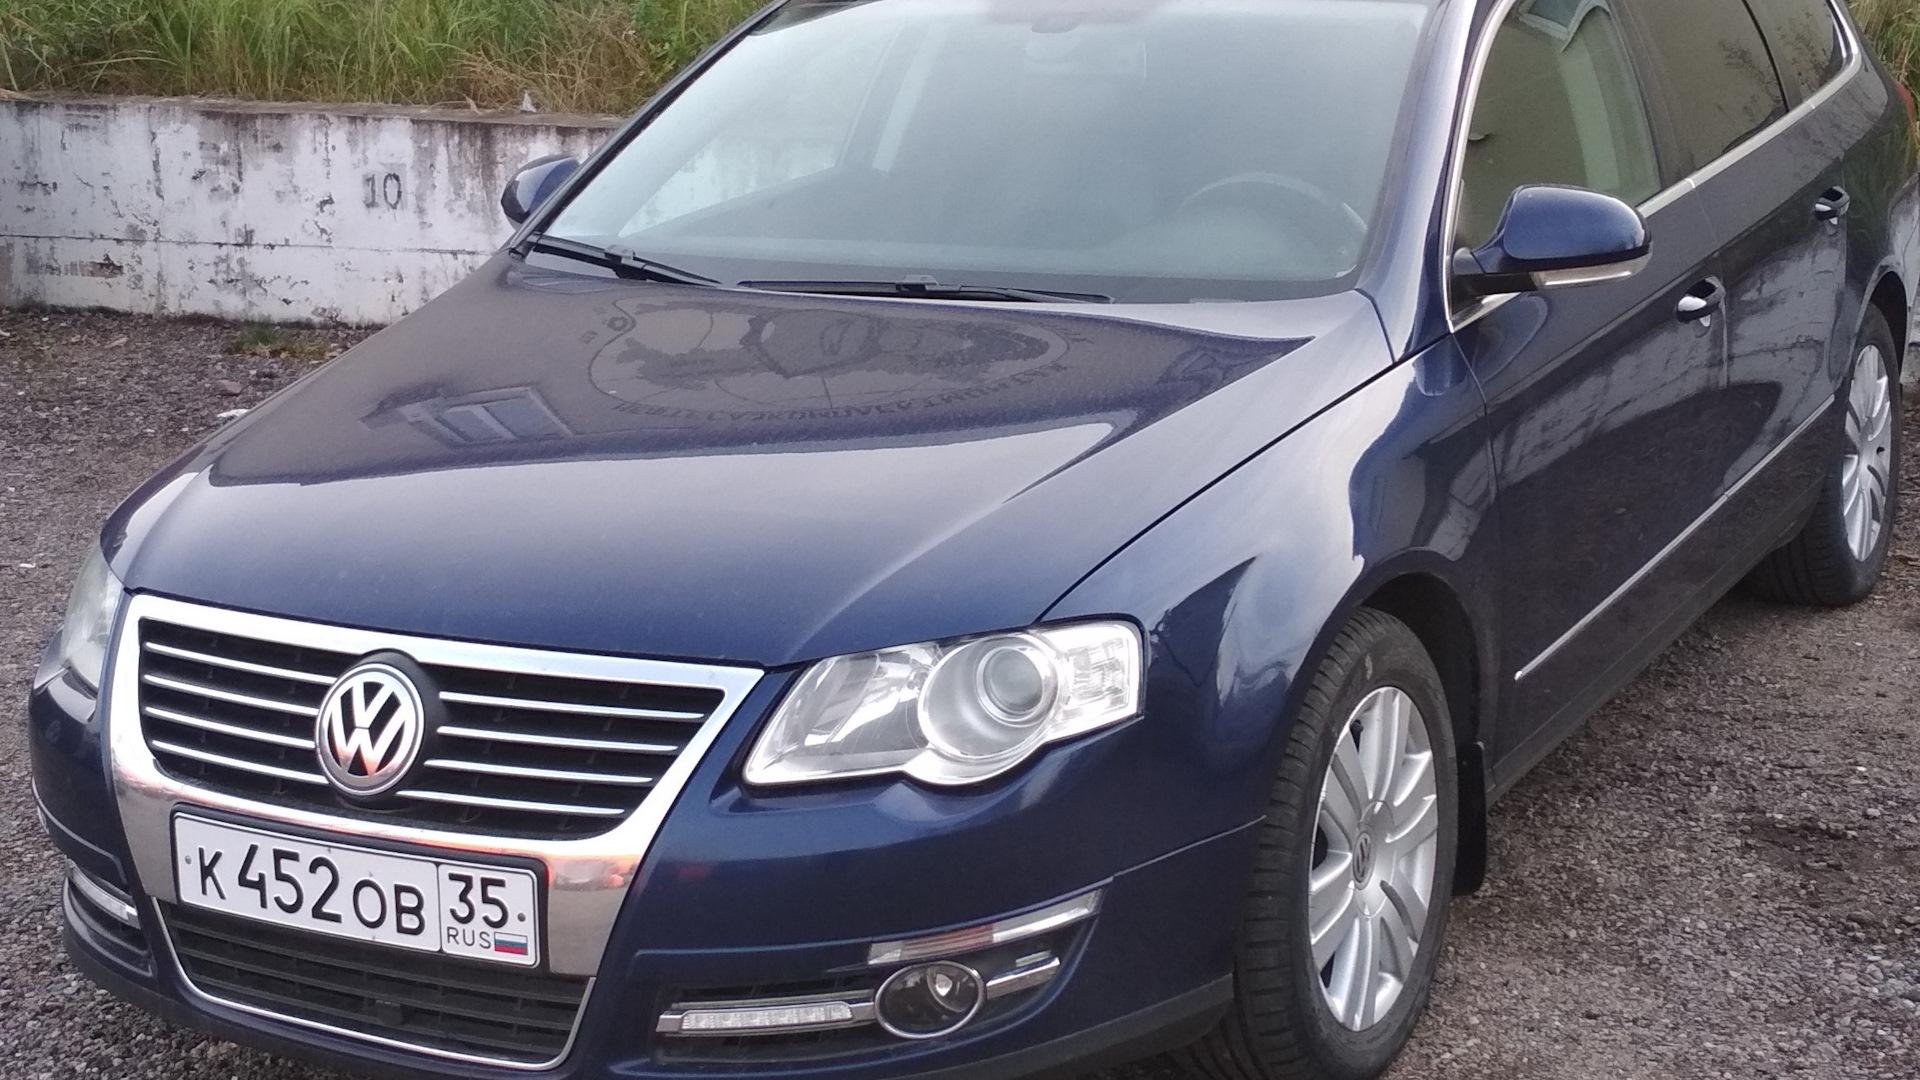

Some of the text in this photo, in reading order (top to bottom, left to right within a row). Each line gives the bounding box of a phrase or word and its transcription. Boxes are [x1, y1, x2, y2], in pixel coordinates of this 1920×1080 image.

[364, 172, 402, 210] 10
[447, 872, 510, 930] 35
[446, 926, 492, 950] RUS
